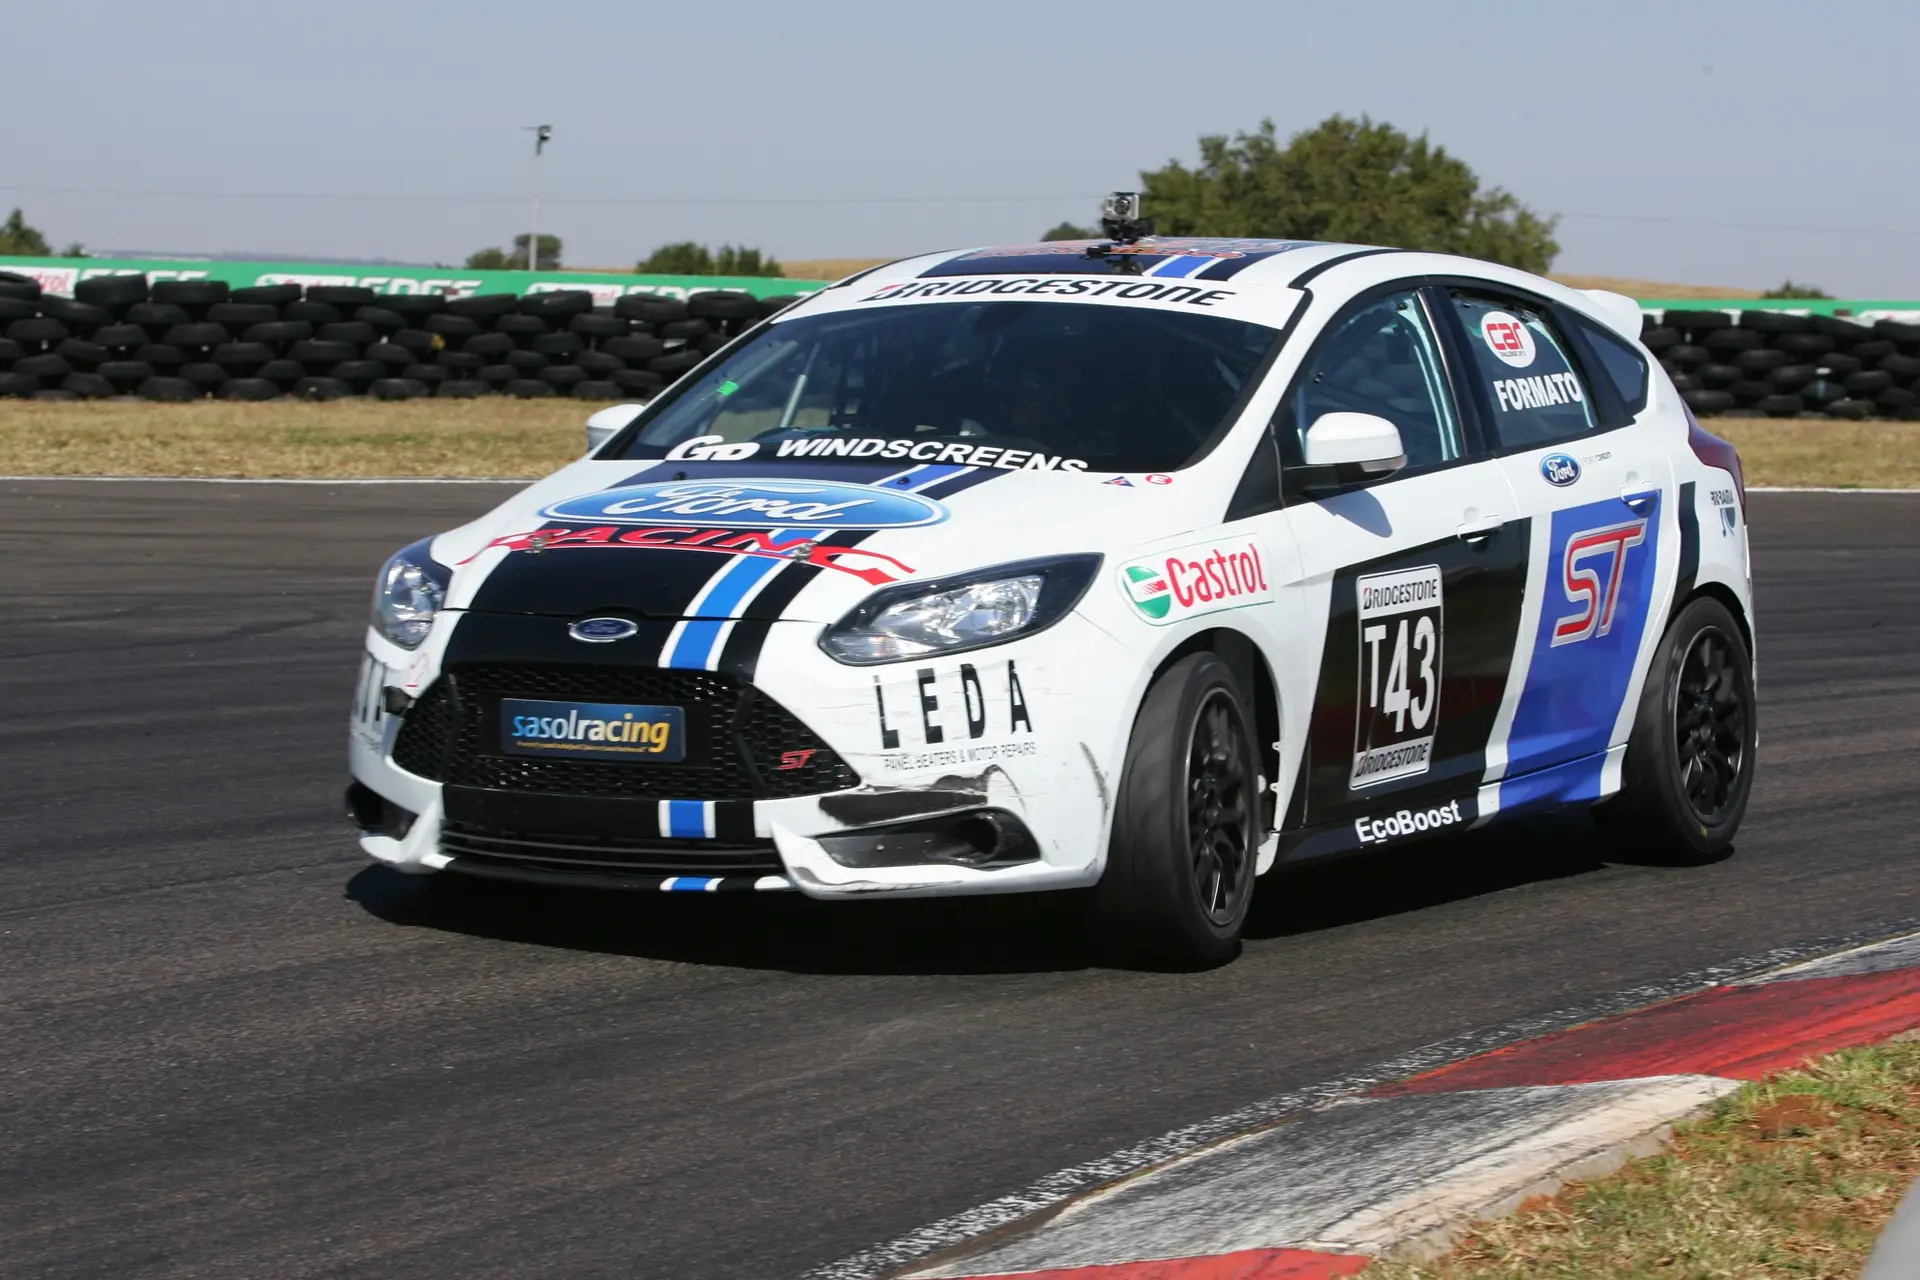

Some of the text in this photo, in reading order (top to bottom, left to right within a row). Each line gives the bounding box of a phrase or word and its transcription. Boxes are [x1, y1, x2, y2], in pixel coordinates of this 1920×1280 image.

[857, 278, 1236, 306] BRIDGESTONE
[1486, 322, 1525, 350] car
[1493, 372, 1583, 412] FORMATO
[776, 438, 1088, 473] WINDSCREENS
[1546, 457, 1575, 482] Ford
[602, 484, 874, 521] Ford
[454, 526, 917, 586] RACING
[1166, 543, 1267, 607] Castrol
[1363, 579, 1437, 610] BRIDGESTONE
[1550, 518, 1648, 648] ST
[1364, 616, 1436, 734] T43
[873, 659, 1032, 749] LEDA
[512, 709, 670, 753] sasolracing
[1000, 741, 1036, 757] REPAIRS
[1354, 742, 1429, 778] BRIDGESTONE
[1355, 799, 1462, 843] EcoBoost
